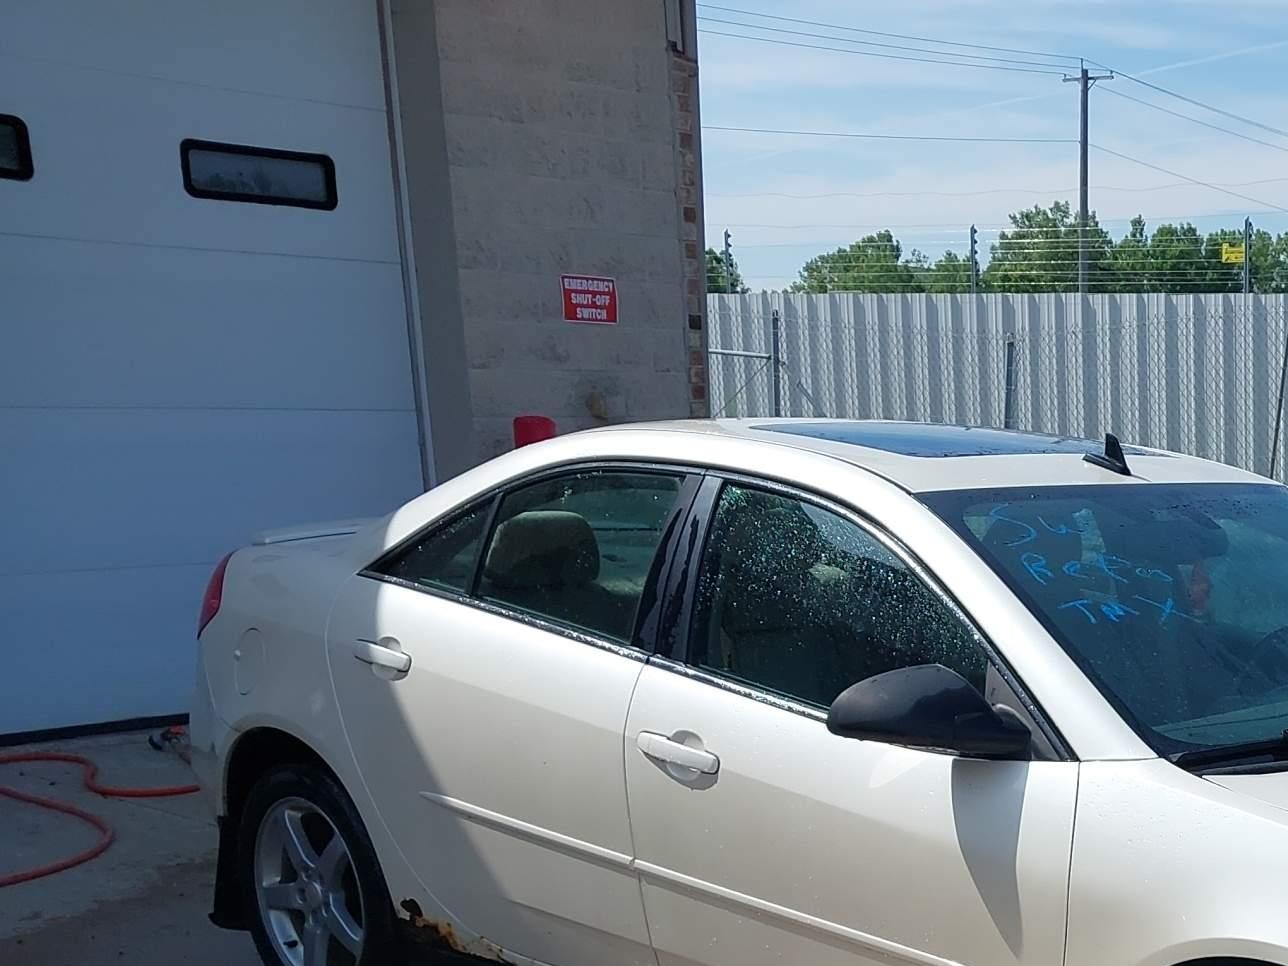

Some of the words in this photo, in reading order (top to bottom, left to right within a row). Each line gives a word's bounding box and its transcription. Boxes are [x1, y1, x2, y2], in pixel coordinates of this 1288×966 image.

[564, 278, 613, 292] EMERGENCY
[571, 293, 610, 306] SHUT-OFF
[576, 307, 607, 320] SWITCH
